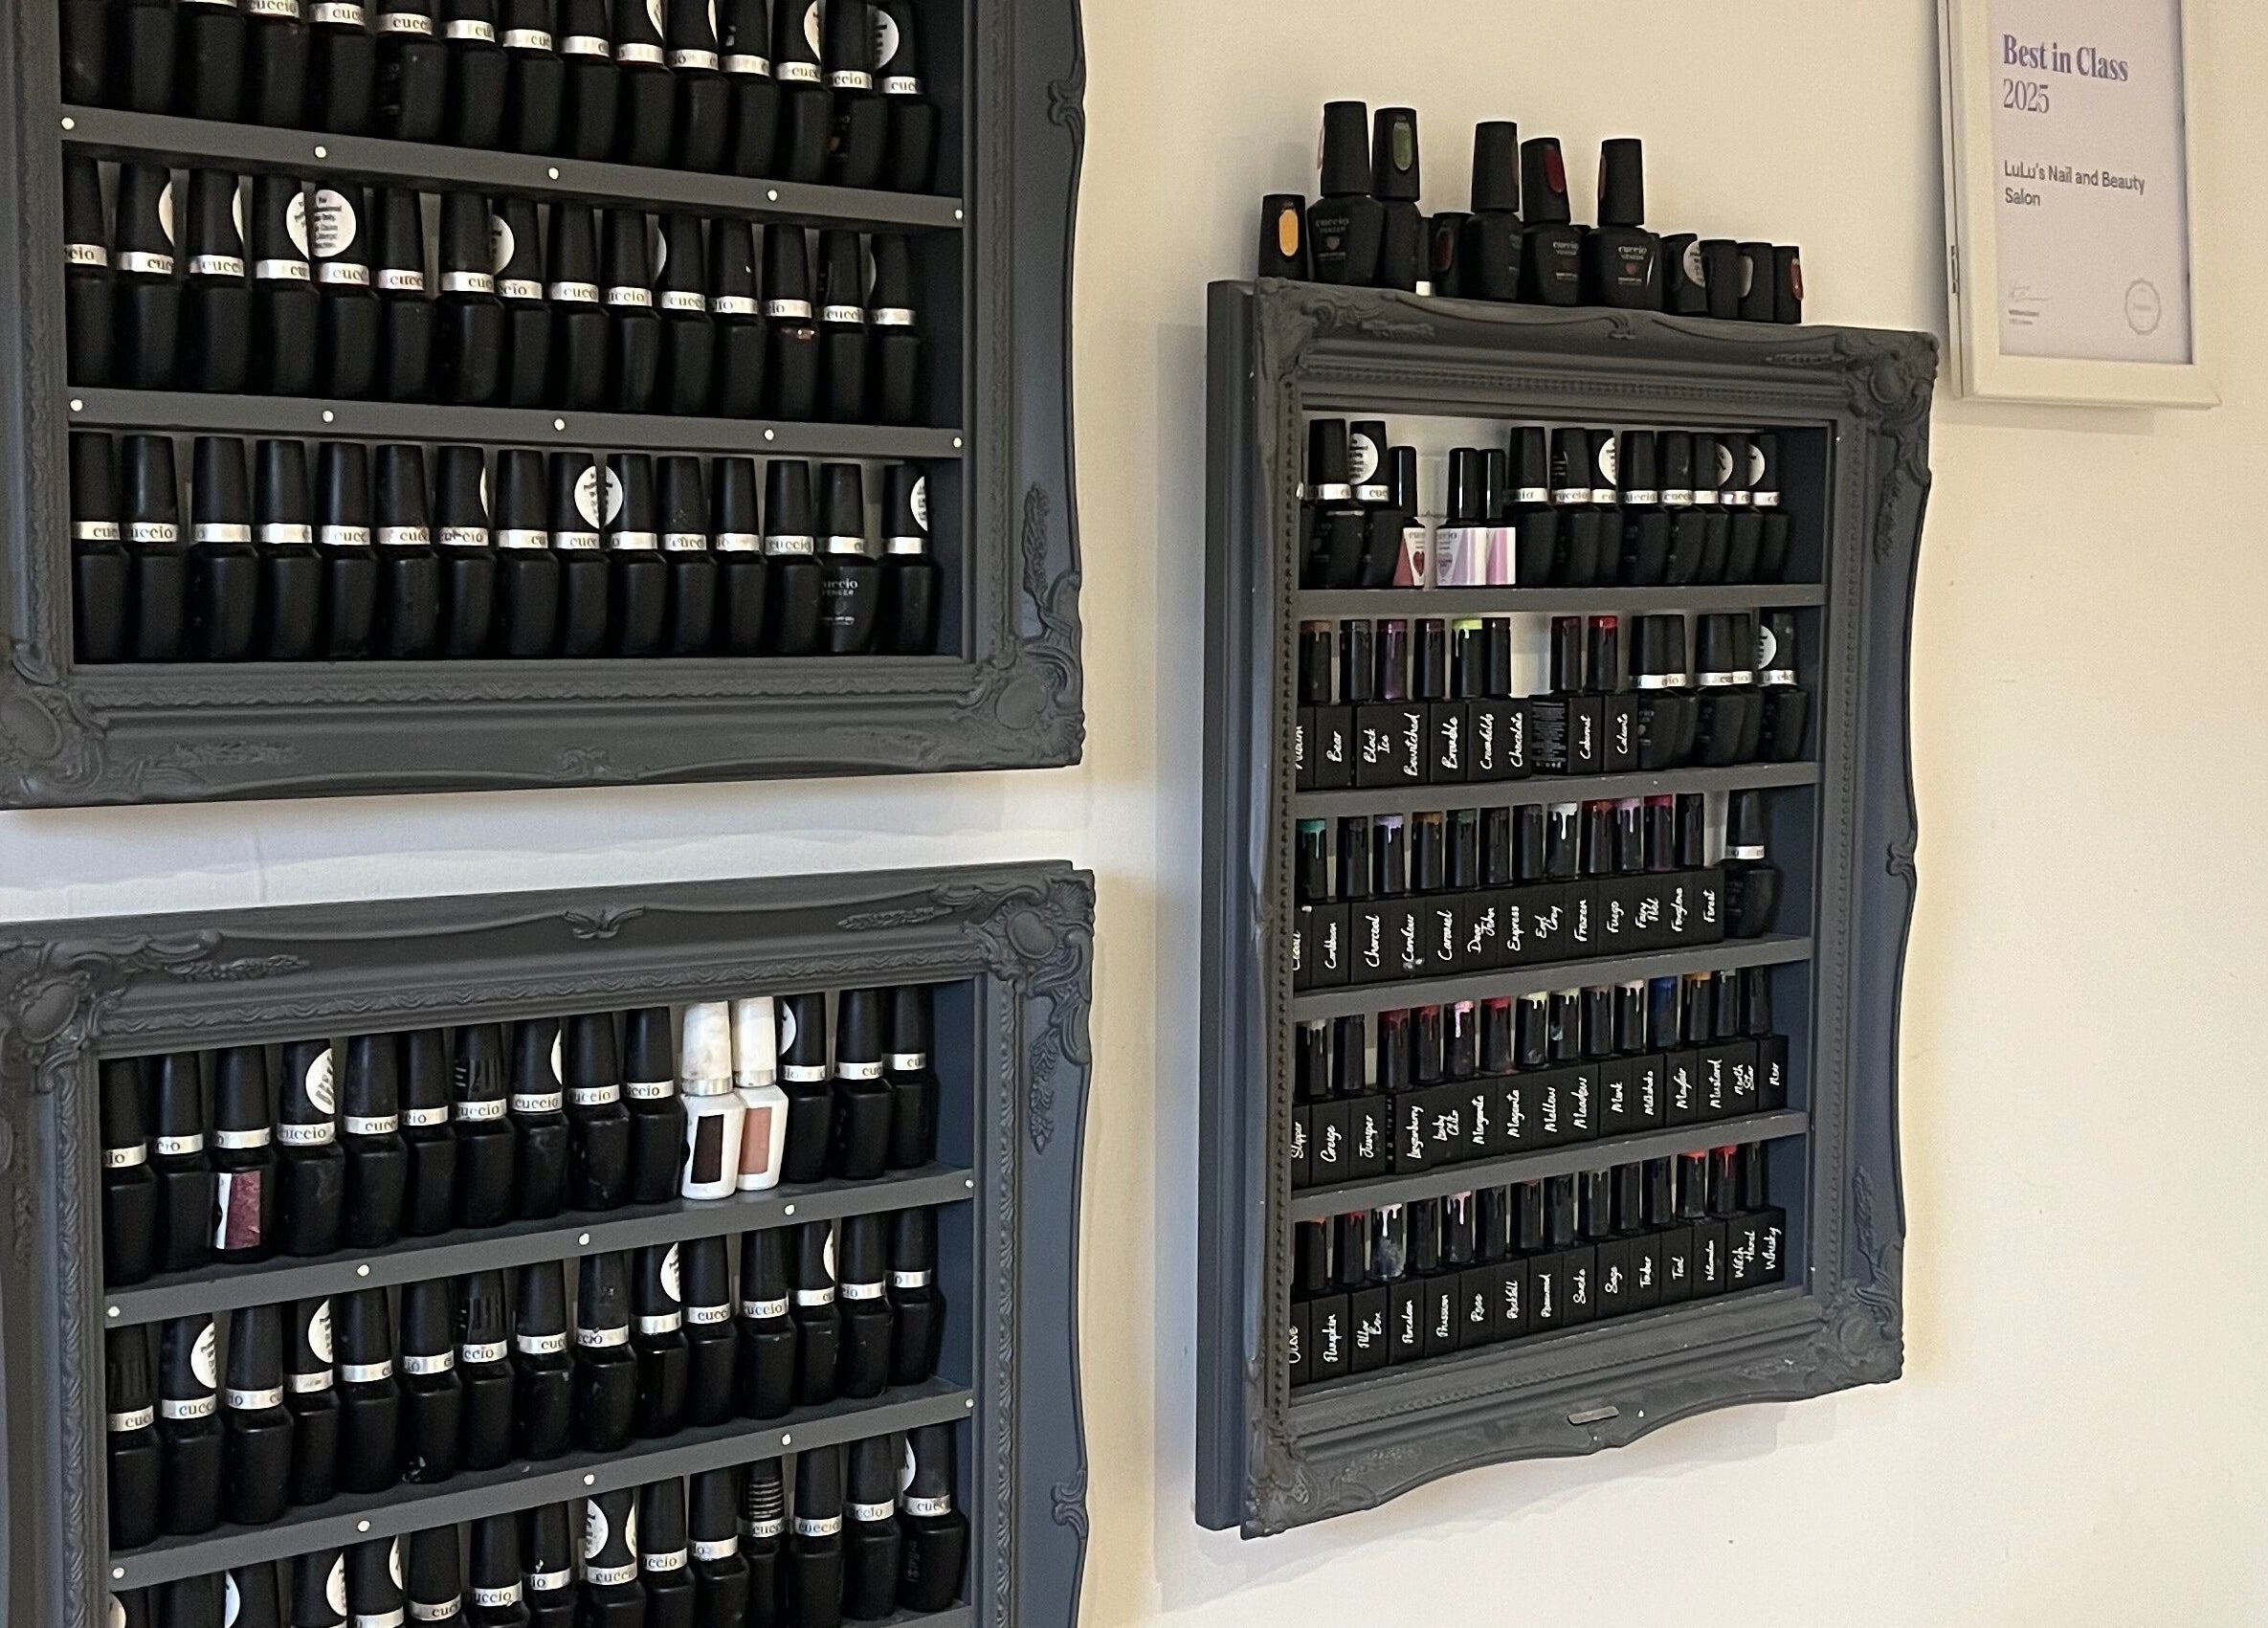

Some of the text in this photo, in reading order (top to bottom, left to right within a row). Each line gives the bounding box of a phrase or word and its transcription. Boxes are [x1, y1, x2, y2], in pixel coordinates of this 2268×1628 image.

[2004, 34, 2127, 81] Best in Class
[2004, 79, 2049, 113] 2025
[2005, 161, 2145, 195] LuLu's Nail and Beauty
[2006, 188, 2040, 206] Salon
[1326, 731, 1342, 762] Bear
[1364, 729, 1376, 763] Black
[1377, 735, 1390, 753] Ice
[1404, 713, 1420, 775] Bewitched
[1441, 717, 1457, 769] Bramble
[1509, 713, 1523, 767] Chocolate
[1480, 907, 1496, 936] John
[1574, 900, 1587, 941] Frozen
[1607, 902, 1624, 932] Fuego
[1634, 902, 1652, 928] Fairy
[1703, 890, 1715, 922] Forest
[1324, 923, 1336, 969] Caribbean
[1364, 915, 1379, 967] Charcoal
[1437, 910, 1452, 960] Caramel
[1467, 924, 1481, 953] Dear
[1507, 906, 1524, 950] Express
[1570, 1077, 1589, 1128] Meadow
[1707, 1059, 1722, 1108] Mustard
[1506, 1090, 1524, 1137] Magenta
[1543, 1087, 1557, 1132] Mellow
[1290, 1120, 1306, 1158] Slipper
[1360, 1115, 1377, 1157] Juniper
[1731, 1246, 1745, 1279] Witch
[1744, 1230, 1755, 1263] Hazel
[1762, 1227, 1781, 1269] Whisky
[1605, 1266, 1622, 1293] Sage
[1672, 1257, 1683, 1280] Teal
[1323, 1314, 1342, 1362] Pumpkin
